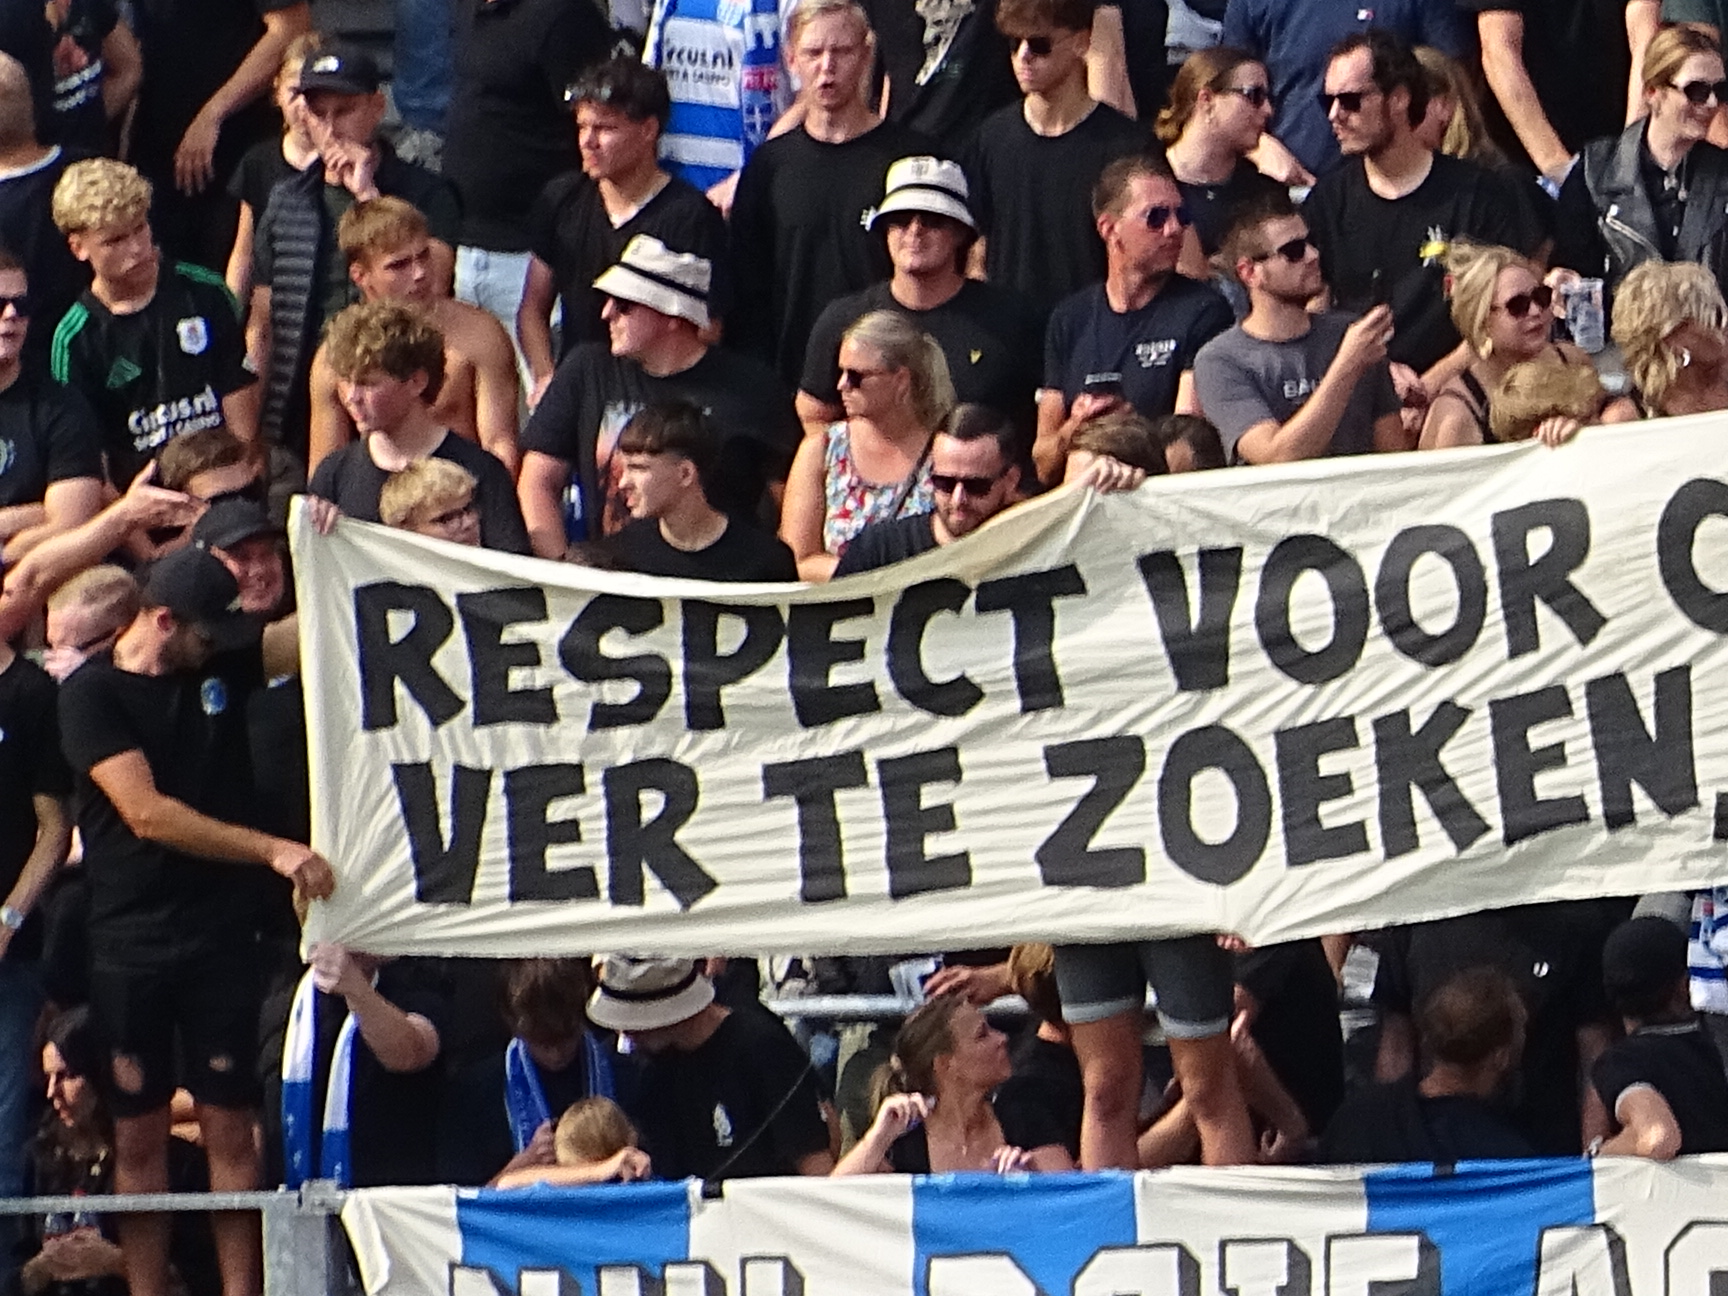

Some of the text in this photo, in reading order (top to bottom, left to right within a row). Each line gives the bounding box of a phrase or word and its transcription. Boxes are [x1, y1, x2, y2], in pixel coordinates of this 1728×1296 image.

[353, 563, 1088, 733] RESPECT
[1137, 497, 1608, 693] VOOR
[391, 757, 719, 911] VER
[762, 746, 972, 904] TE
